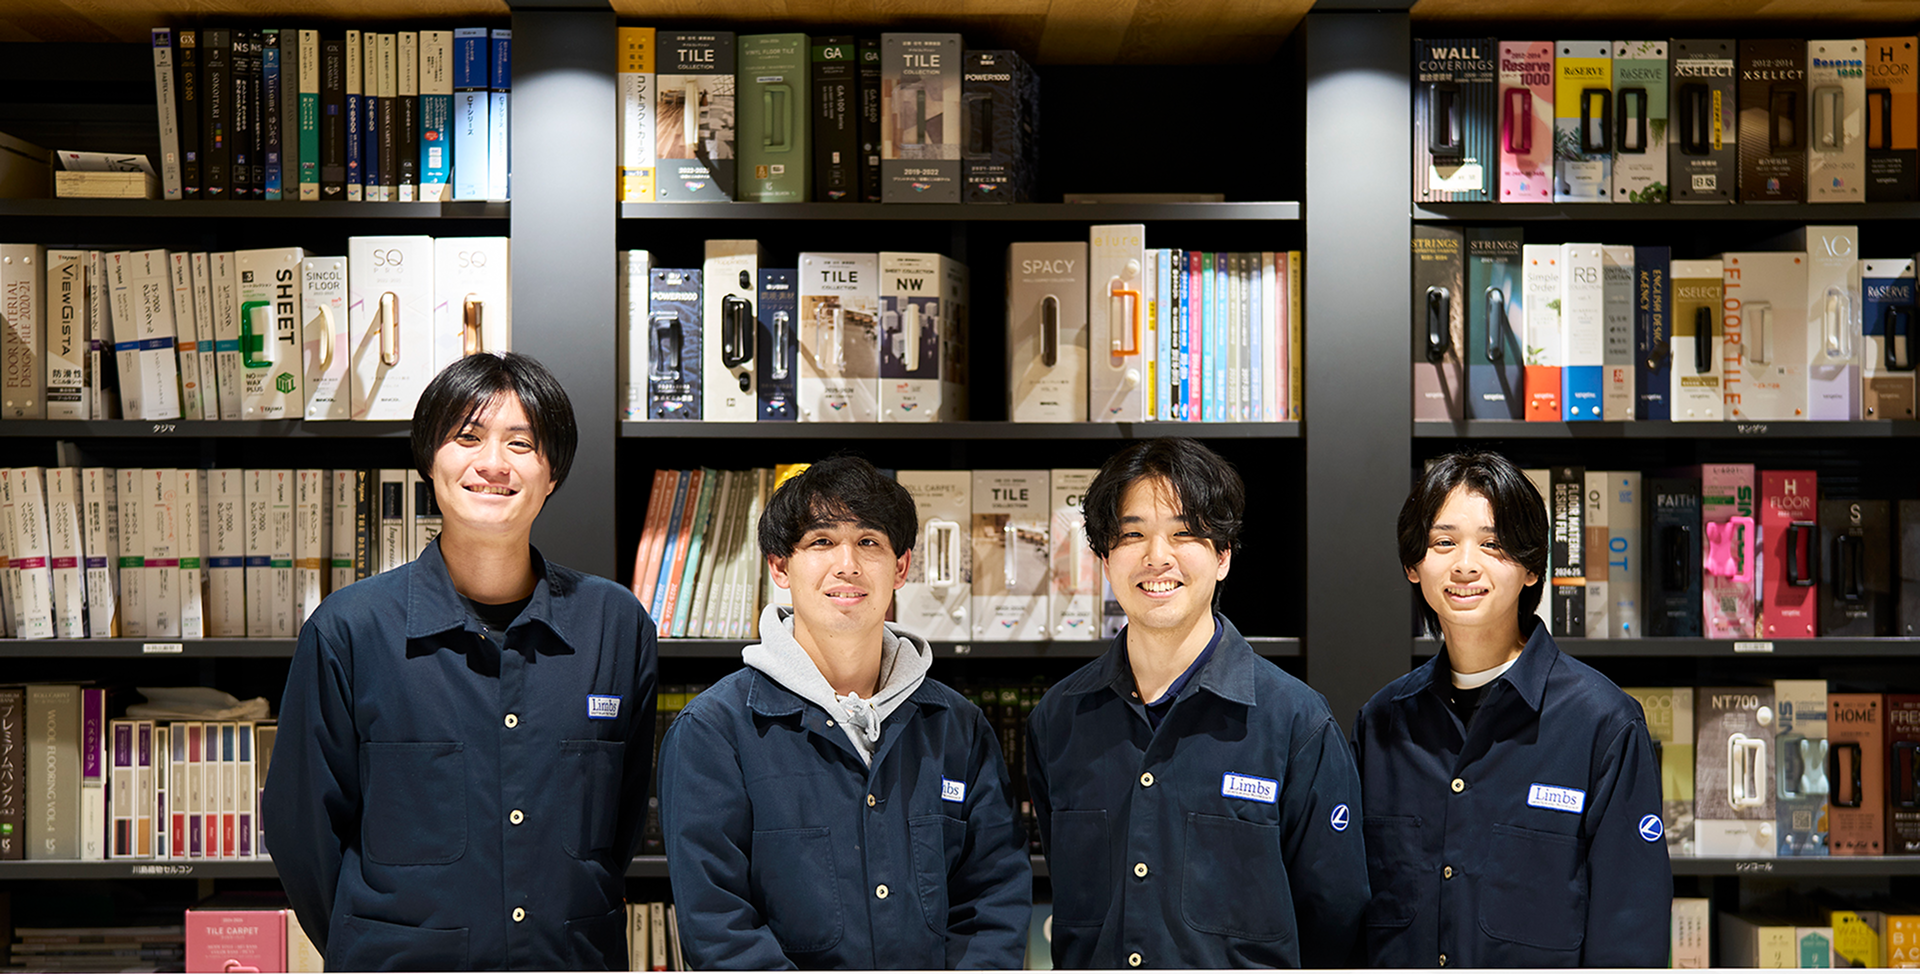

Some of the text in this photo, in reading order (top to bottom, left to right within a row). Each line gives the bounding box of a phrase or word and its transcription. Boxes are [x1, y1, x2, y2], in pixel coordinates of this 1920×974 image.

[180, 36, 195, 44] GX
[234, 42, 249, 52] NS
[251, 43, 262, 51] NS
[677, 50, 714, 62] TILE
[824, 48, 843, 59] GA
[865, 52, 879, 61] GA
[1432, 47, 1480, 60] WALL
[1880, 47, 1893, 62] H
[903, 55, 940, 67] TILE
[1419, 61, 1494, 71] COVERINGS
[1502, 59, 1550, 72] Reserve
[1813, 58, 1862, 67] Reserve
[1674, 65, 1734, 77] XSELECT
[1743, 70, 1804, 80] XSELECT
[1837, 69, 1862, 77] 1000
[1520, 73, 1550, 86] 1000
[185, 72, 193, 101] GX-300
[268, 73, 277, 112] Yuisome
[836, 85, 845, 112] GA-100
[637, 75, 646, 165] コントラクトカーテン
[1411, 239, 1459, 249] STRINGS
[1470, 241, 1519, 249] STRINGS
[374, 249, 404, 266] SQ
[459, 251, 487, 268] SQ
[1022, 259, 1075, 274] SPACY
[306, 272, 342, 281] SINCOL
[821, 271, 858, 282] TILE
[1527, 273, 1559, 283] Simple
[1574, 267, 1597, 283] RB
[308, 281, 340, 290] FLOOR
[896, 279, 924, 290] NW
[1529, 284, 1556, 292] Order
[151, 283, 160, 313] TS-7000
[651, 292, 698, 301] POWER1000
[1678, 287, 1721, 298] XSELECT
[276, 269, 294, 345] SHEET
[7, 281, 19, 388] FLOOR MATERIAL
[20, 281, 31, 388] DESIGN FILE 2020-21
[1653, 314, 1662, 346] DESIG
[1724, 268, 1741, 405] FLOOR TILE
[52, 369, 81, 378] 防滑性
[153, 424, 176, 433] タジマ
[1784, 479, 1796, 495] H
[991, 488, 1029, 500] TILE
[1589, 490, 1600, 510] OT
[1657, 495, 1696, 507] FAITH
[1771, 497, 1809, 509] FLOOR
[1555, 483, 1567, 543] DESIGN FILE
[1850, 504, 1861, 522] S
[1568, 483, 1580, 566] FLOOR MATERIAL
[1609, 537, 1628, 571] OT
[1555, 568, 1581, 576] 2024-25
[592, 698, 617, 712] Limbs
[1835, 710, 1876, 722] HOME
[47, 710, 56, 743] WOOL
[87, 719, 95, 770] ベスタフロア
[47, 745, 56, 799] FLOORING
[1229, 777, 1271, 796] Limbs
[1535, 787, 1577, 805] Limbs
[1736, 863, 1772, 871] シンコール
[206, 927, 258, 935] TILE CARPET
